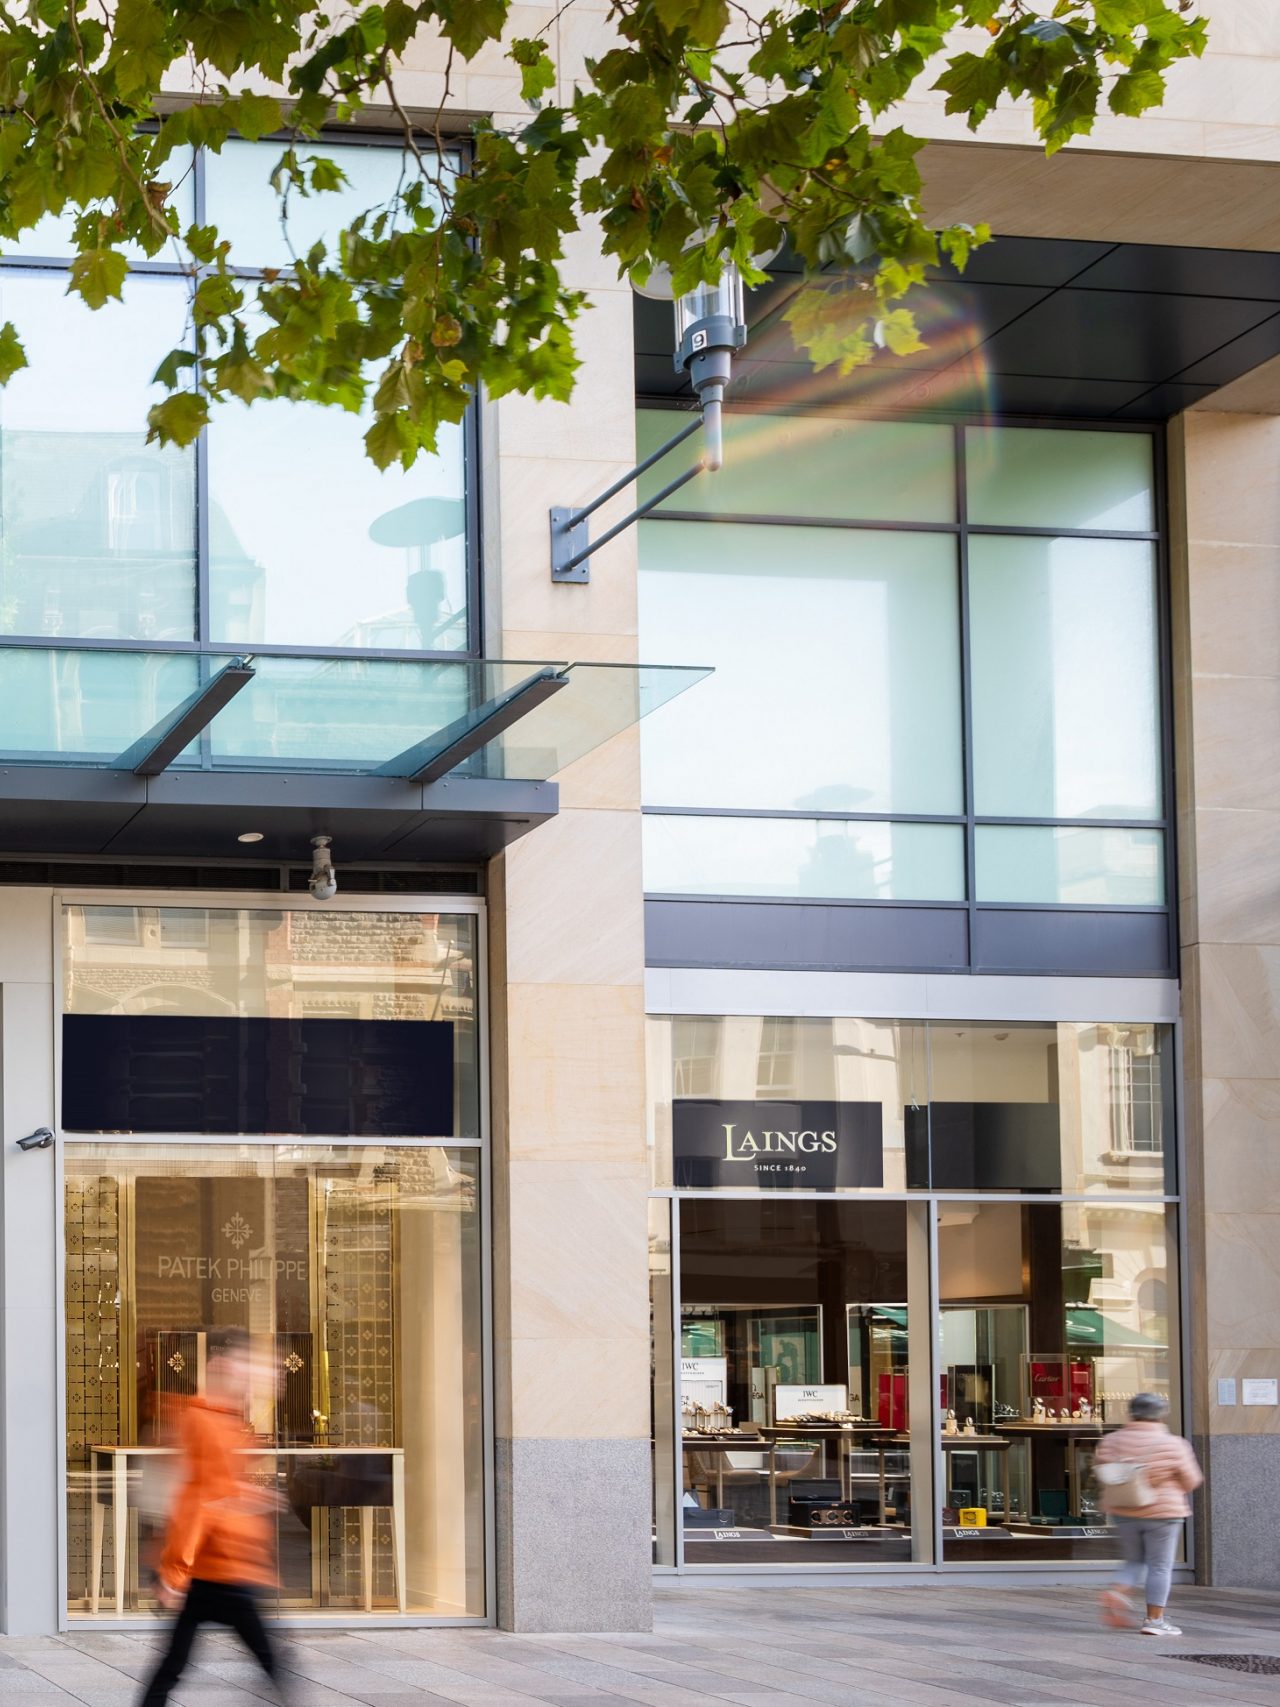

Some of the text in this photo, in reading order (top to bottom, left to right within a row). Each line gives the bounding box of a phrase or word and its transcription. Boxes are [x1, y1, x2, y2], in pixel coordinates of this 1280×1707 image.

[694, 334, 705, 348] 9
[721, 1124, 838, 1161] LAINGS
[158, 1256, 307, 1281] PATEK PHILIPPE
[682, 1362, 700, 1372] IWC
[802, 1390, 819, 1398] IWC
